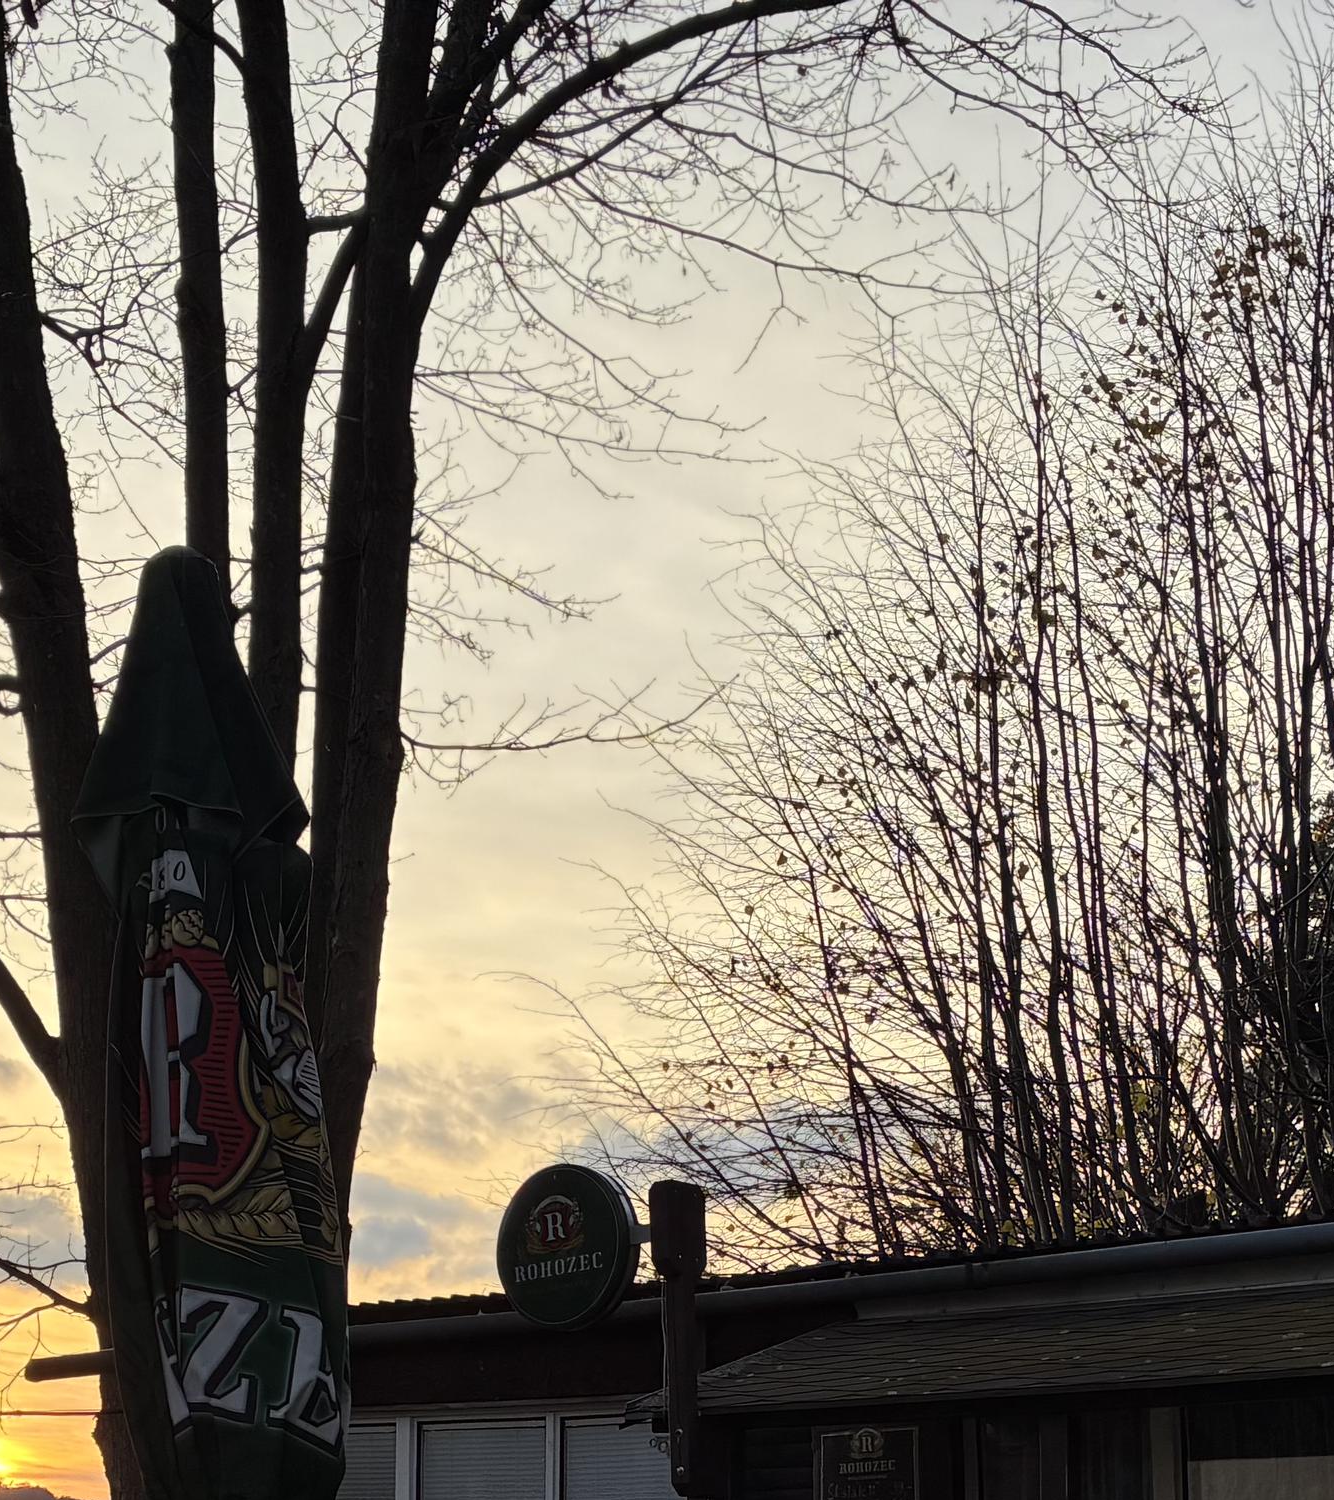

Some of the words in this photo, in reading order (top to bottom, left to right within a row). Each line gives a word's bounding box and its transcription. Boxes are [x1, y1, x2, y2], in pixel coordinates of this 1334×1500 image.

[543, 1210, 567, 1243] R
[514, 1250, 604, 1283] ROHOZEC
[838, 1459, 896, 1475] ROHOZEC
